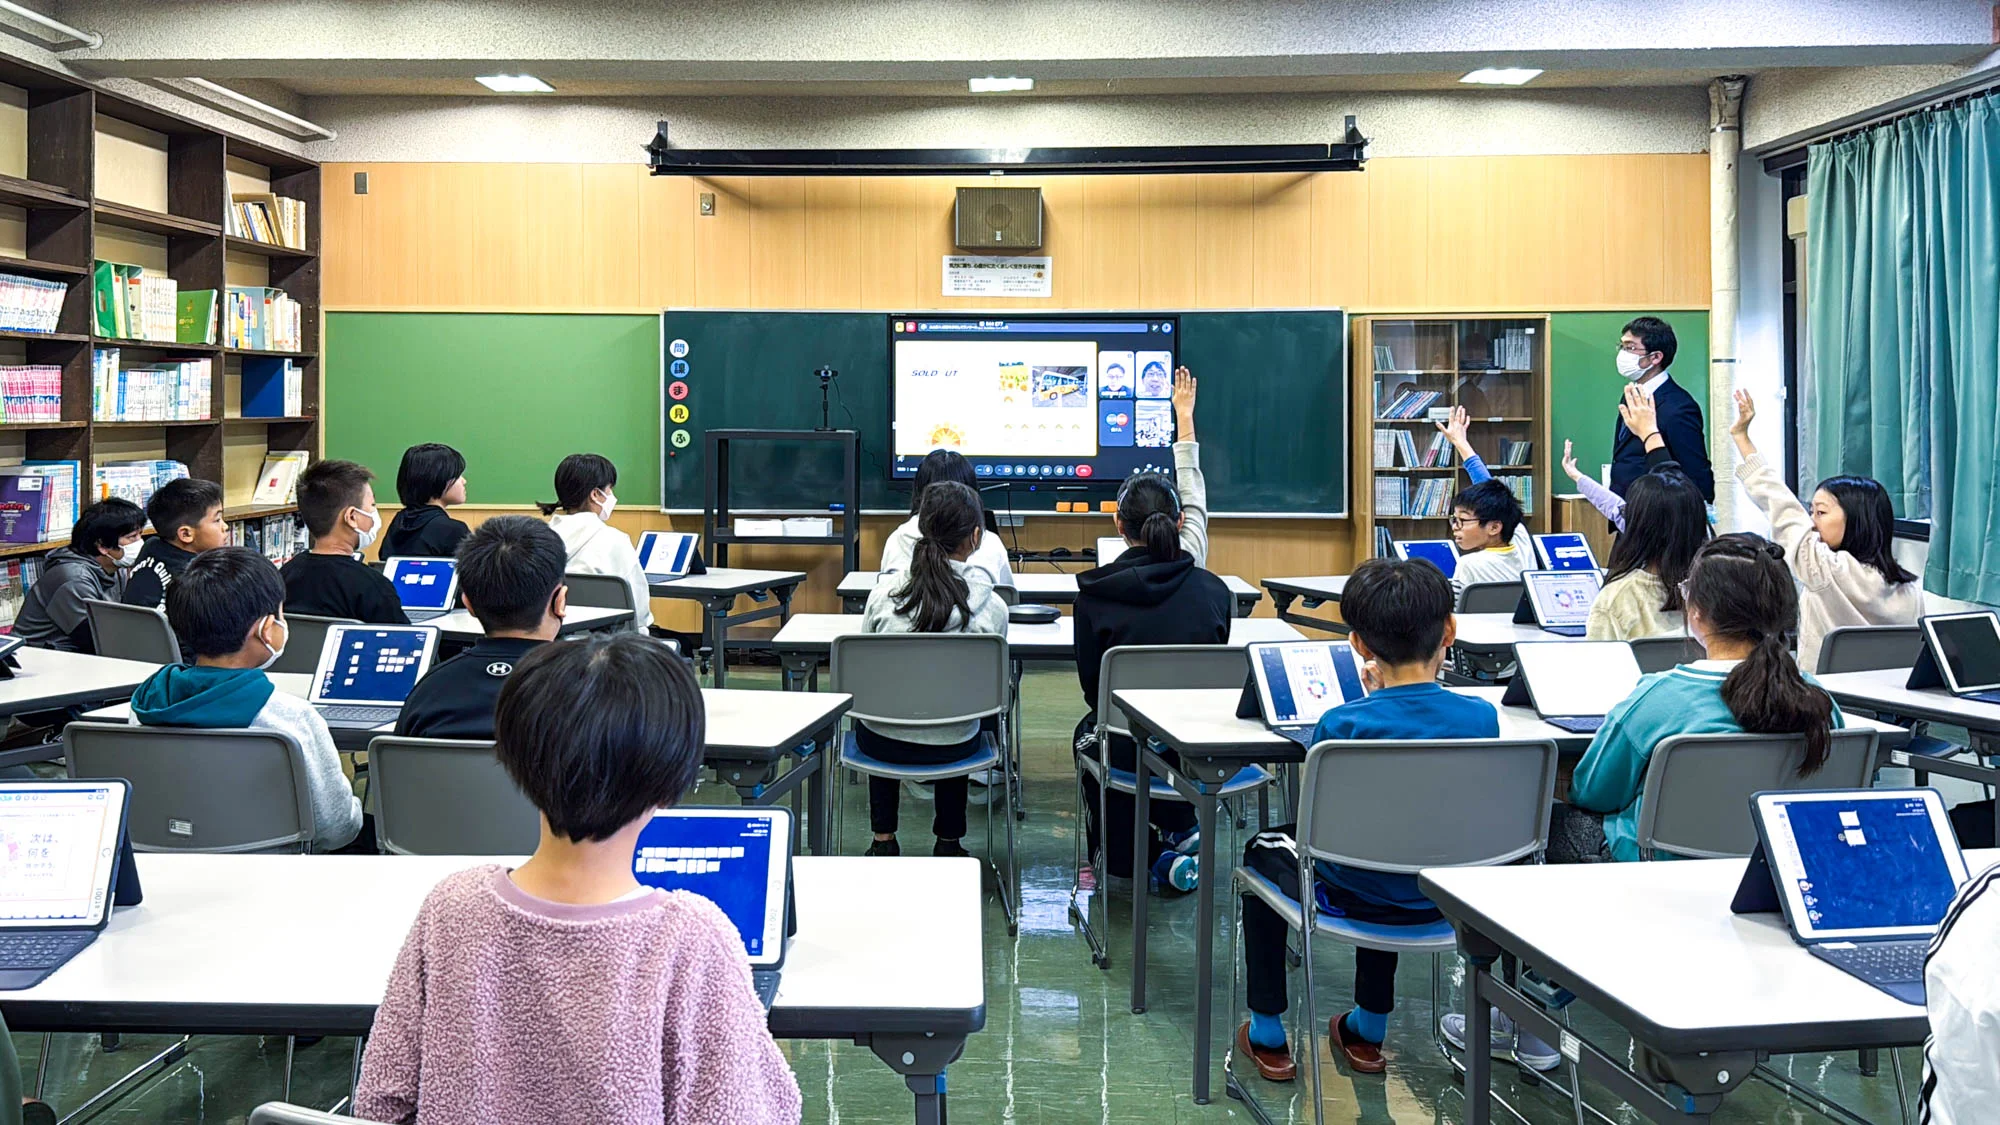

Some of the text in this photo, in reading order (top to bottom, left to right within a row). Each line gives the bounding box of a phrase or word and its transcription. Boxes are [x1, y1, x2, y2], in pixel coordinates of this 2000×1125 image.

[673, 343, 685, 354] 問
[673, 385, 684, 396] ま
[673, 407, 685, 419] 見
[675, 433, 686, 444] ふ
